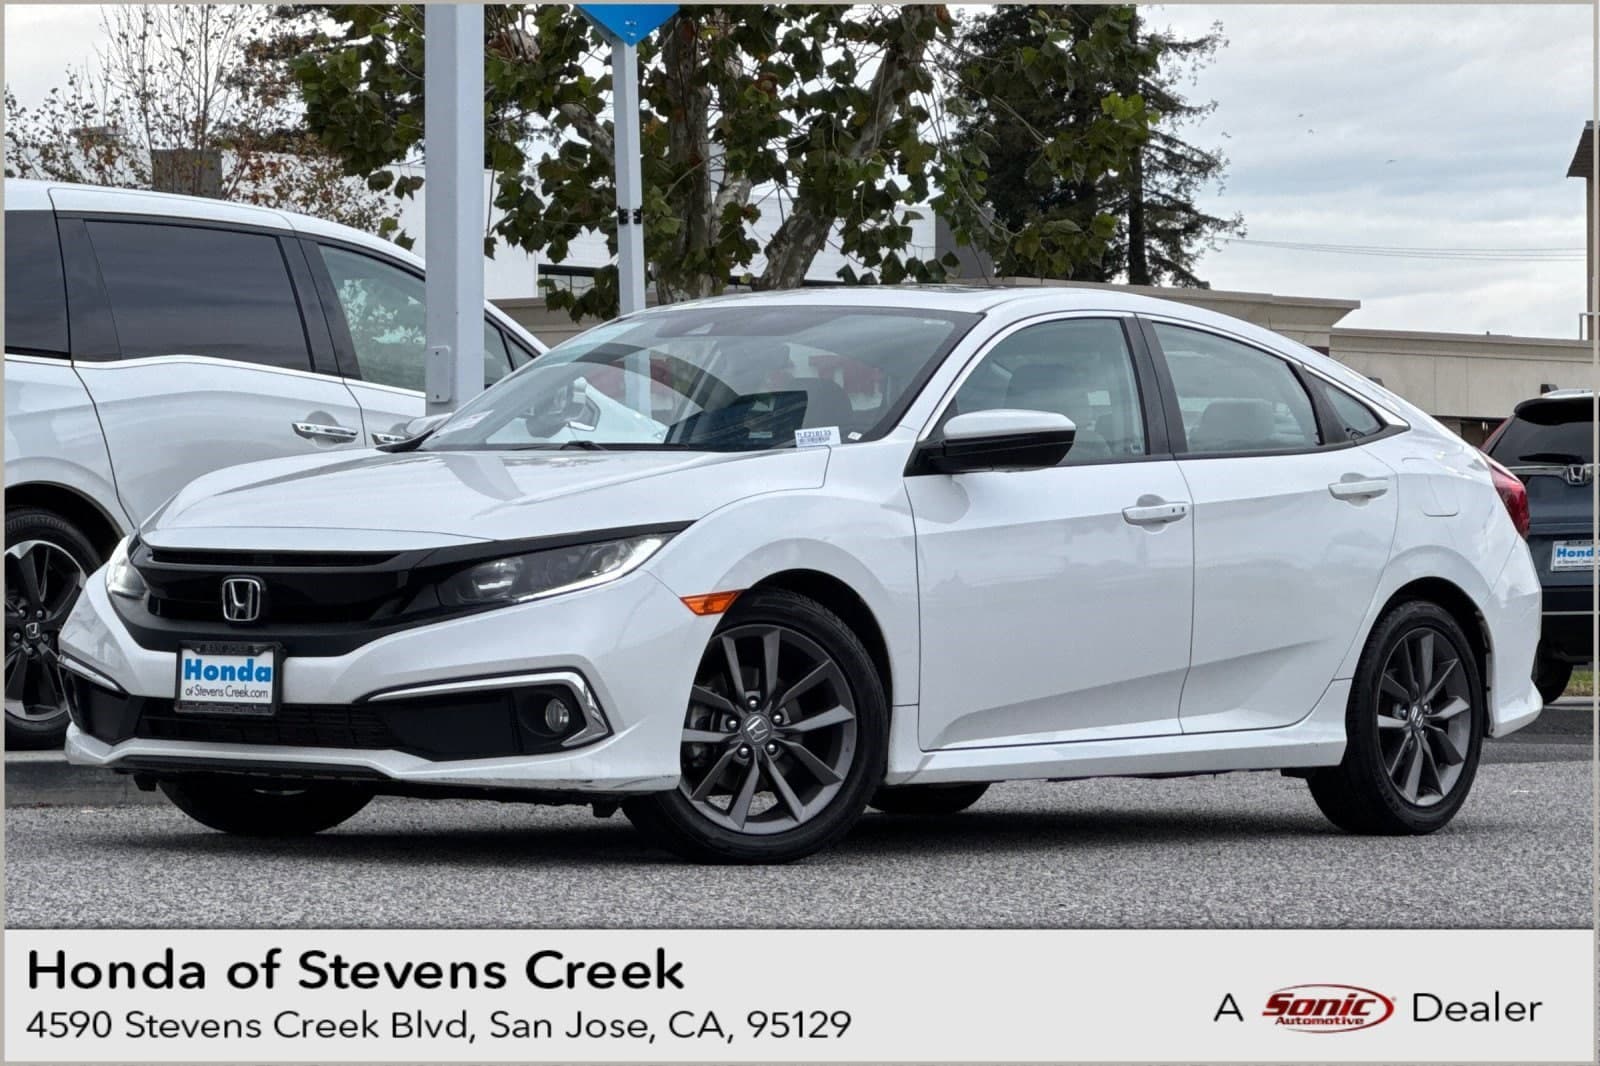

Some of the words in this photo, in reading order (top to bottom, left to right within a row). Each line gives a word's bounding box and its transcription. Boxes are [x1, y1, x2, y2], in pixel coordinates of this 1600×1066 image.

[1556, 547, 1594, 557] Hond
[184, 658, 272, 683] Honda
[185, 687, 194, 697] of
[194, 684, 225, 697] Stevens
[225, 685, 269, 699] Creek.com
